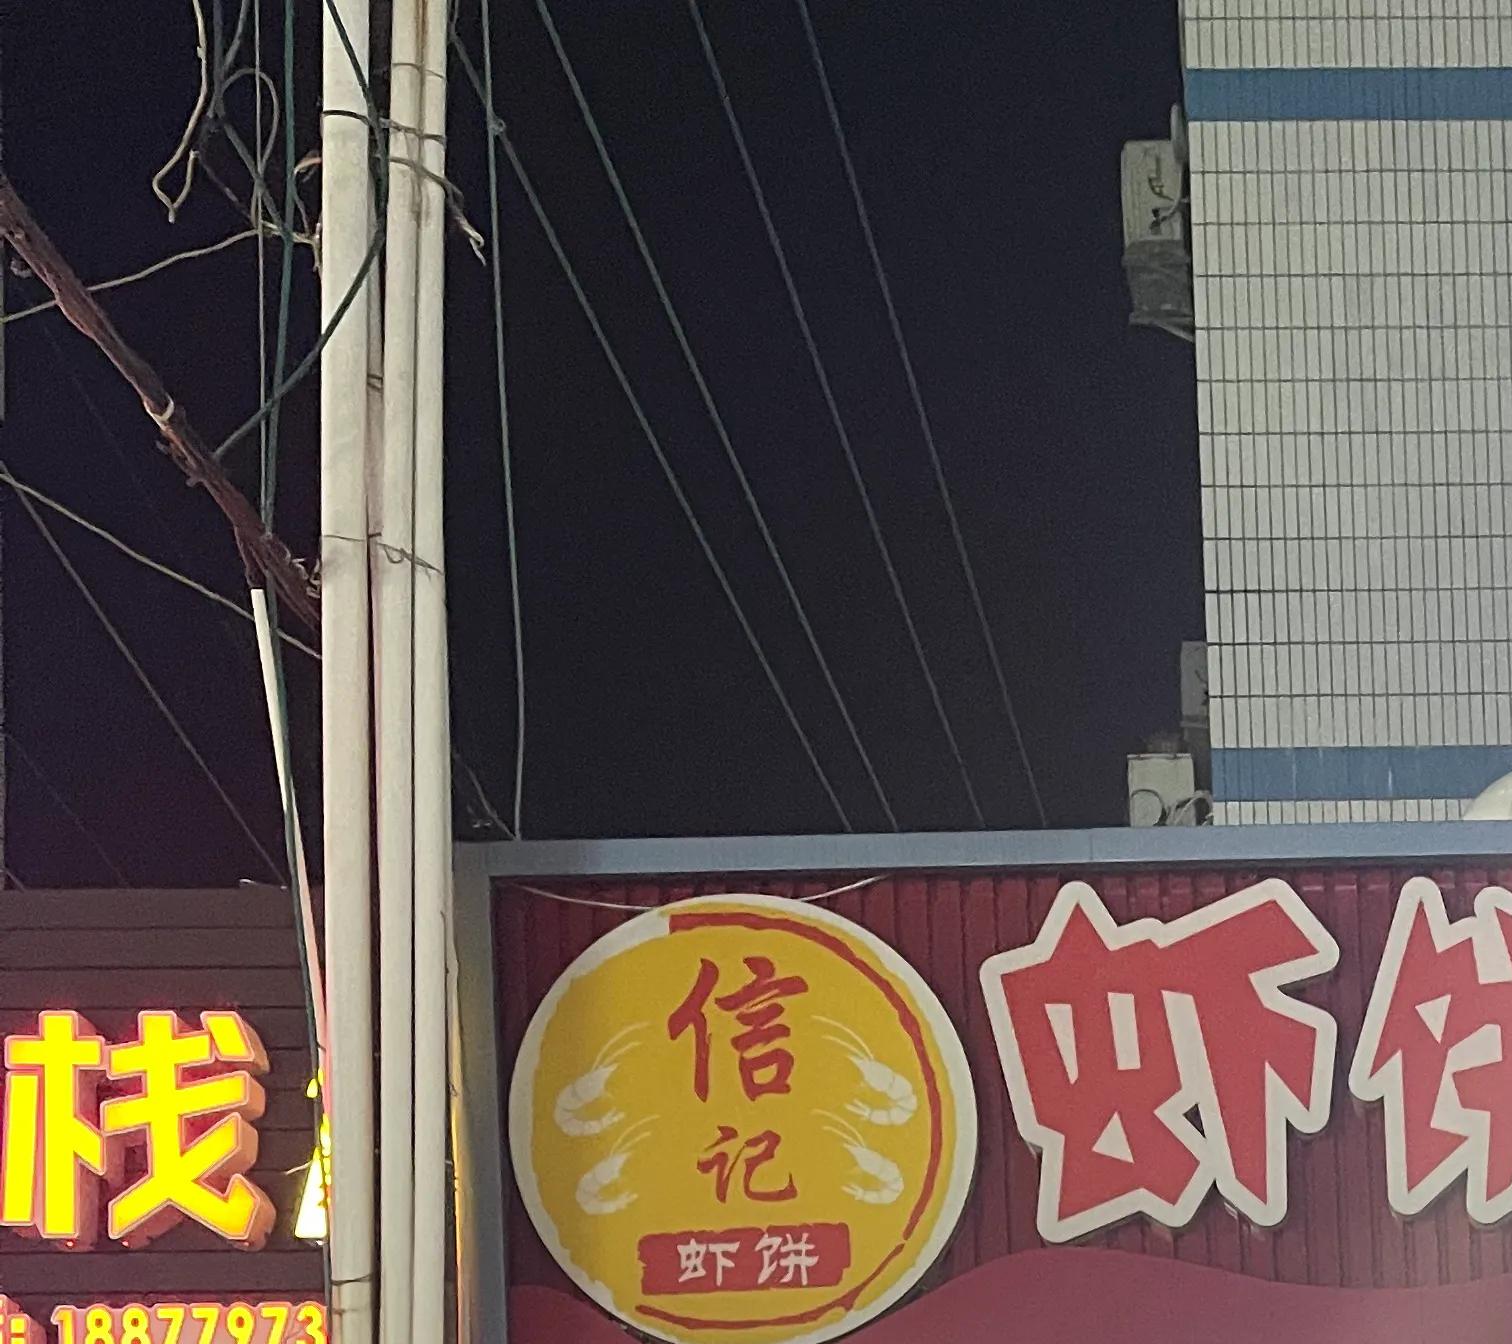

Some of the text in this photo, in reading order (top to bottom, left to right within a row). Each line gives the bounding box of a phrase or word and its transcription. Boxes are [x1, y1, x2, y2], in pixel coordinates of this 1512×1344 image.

[0, 1010, 258, 1239] 栈
[667, 954, 810, 1204] 信记
[676, 1233, 820, 1286] 虾饼
